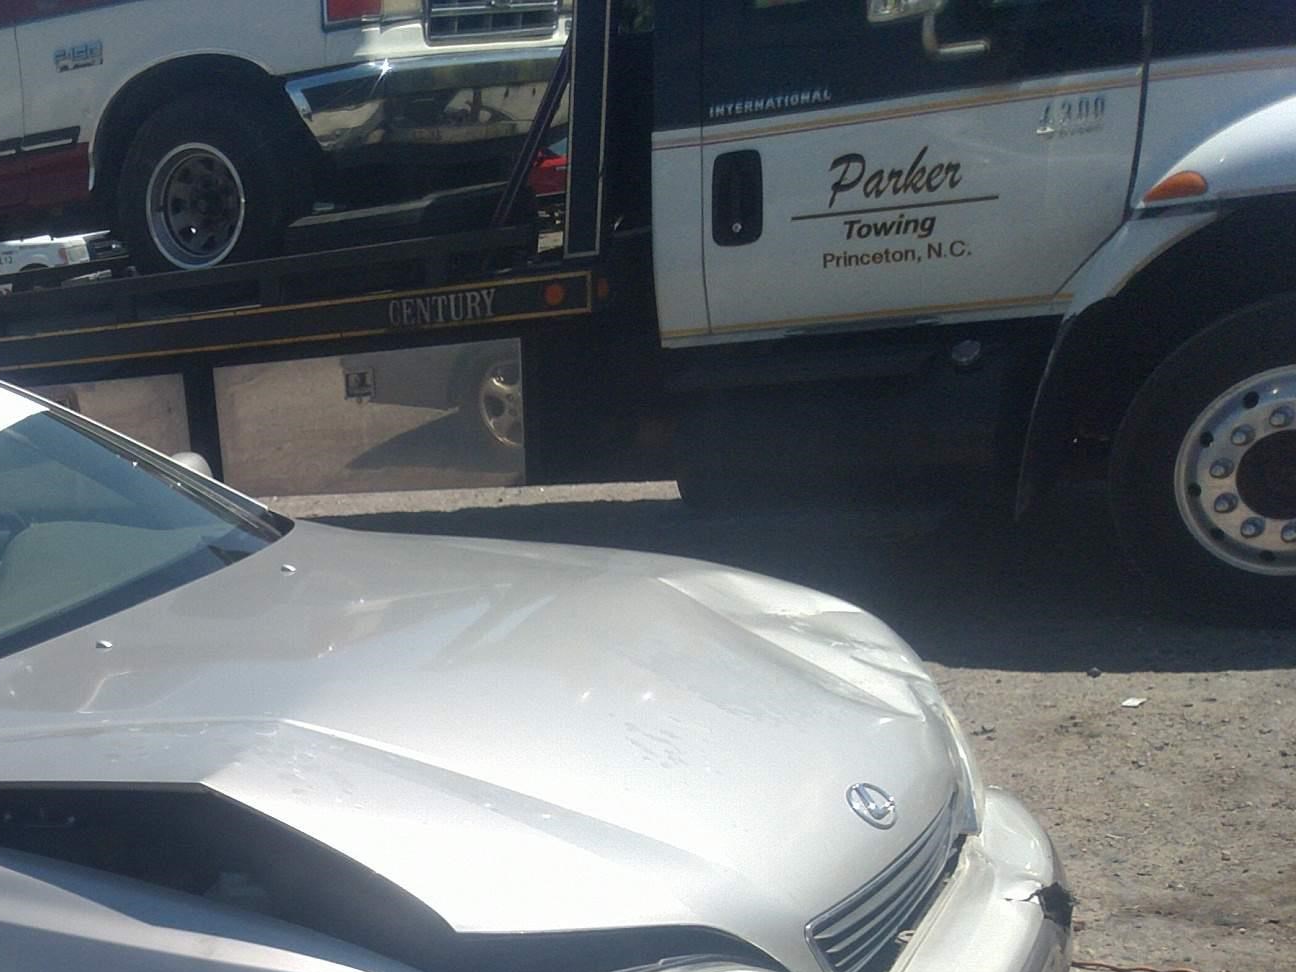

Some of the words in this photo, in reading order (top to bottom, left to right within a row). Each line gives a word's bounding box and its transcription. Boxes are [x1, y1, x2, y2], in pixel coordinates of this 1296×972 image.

[709, 89, 832, 118] INTERNATIONAL
[829, 145, 962, 208] Parker
[843, 214, 936, 240] Towing
[823, 248, 921, 268] Princeton,
[927, 240, 972, 259] N.C.
[388, 288, 496, 327] CENTURY
